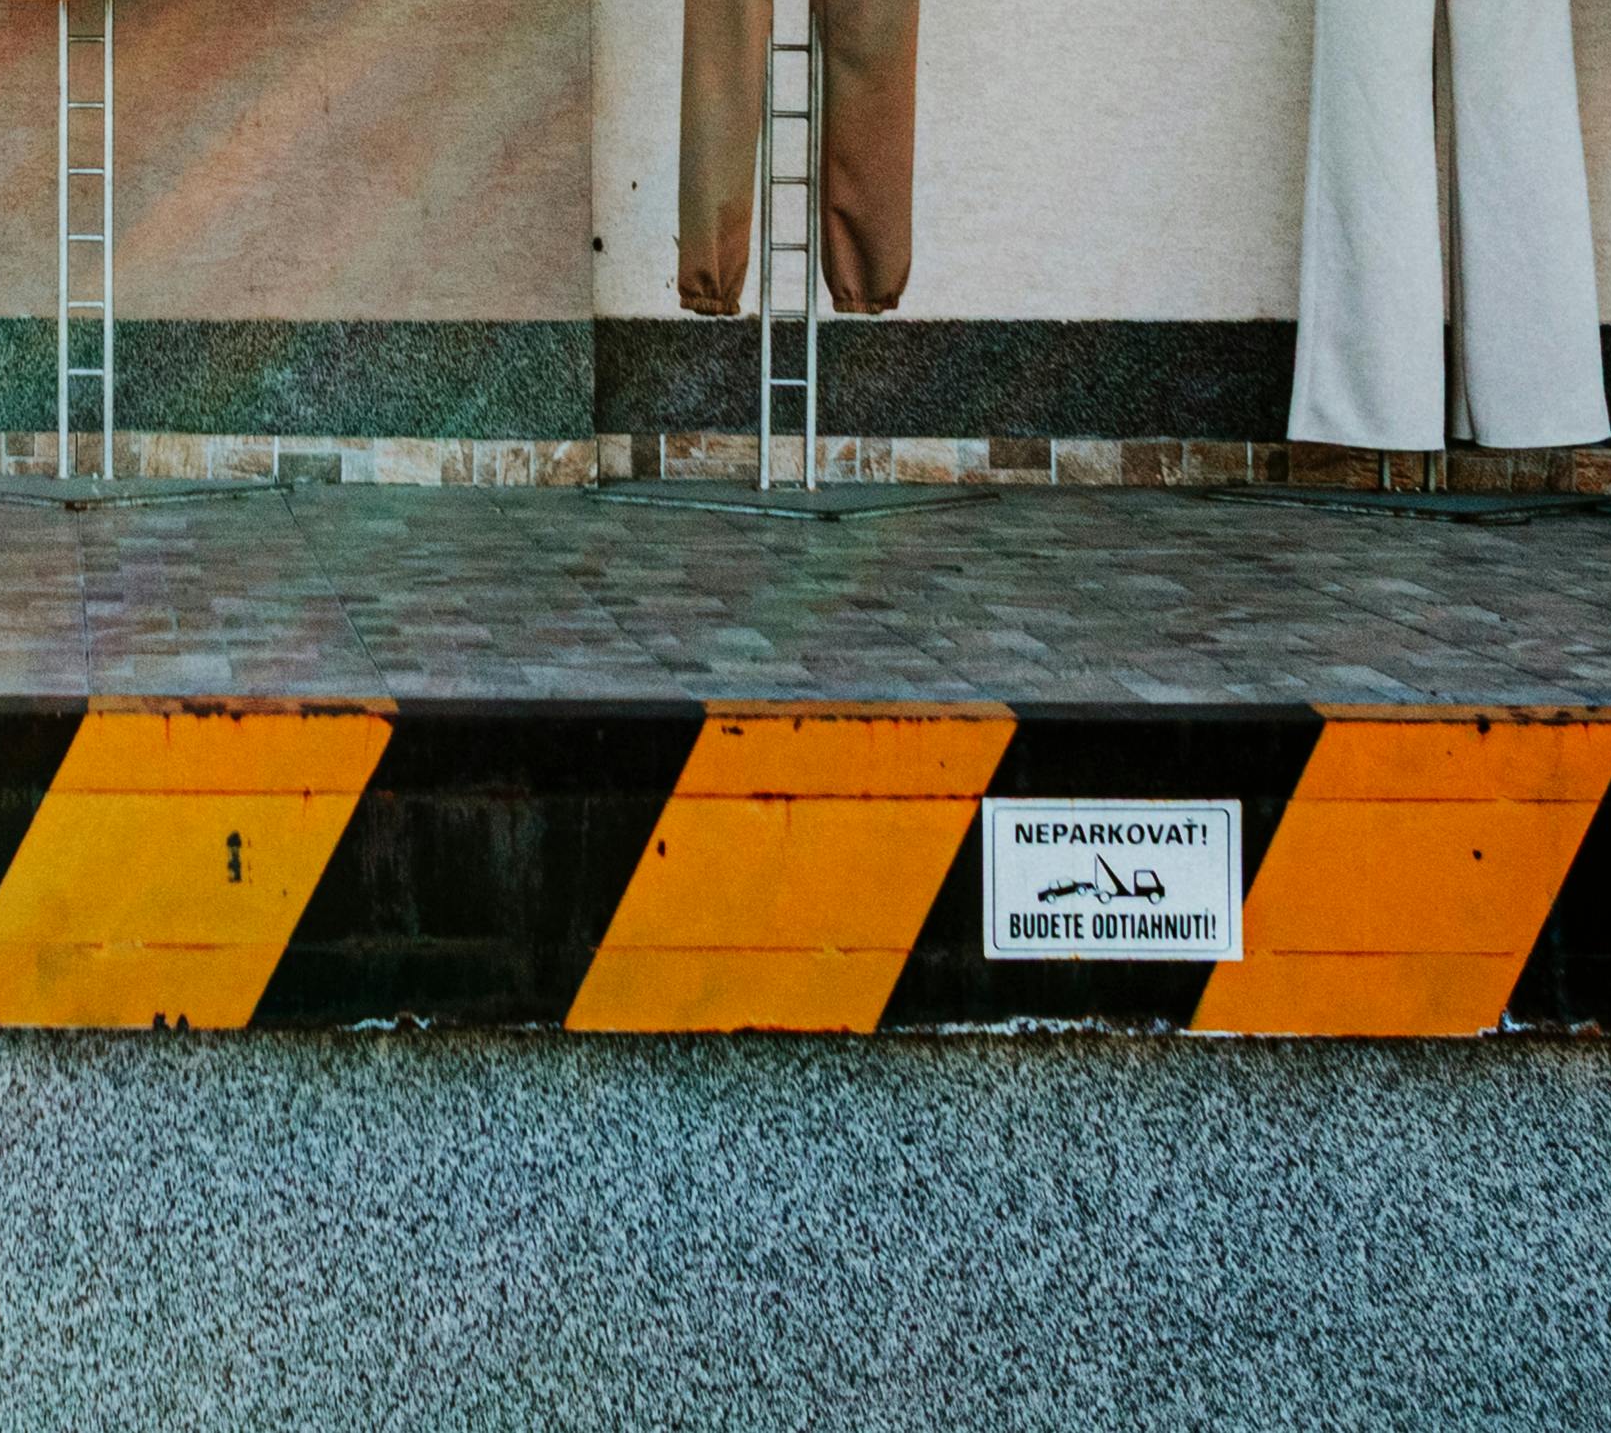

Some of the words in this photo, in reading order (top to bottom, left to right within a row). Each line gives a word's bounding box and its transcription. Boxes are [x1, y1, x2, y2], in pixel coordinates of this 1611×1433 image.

[1015, 816, 1207, 845] NEPARKOVAŤ!
[1010, 913, 1084, 939] BUDETE
[1093, 908, 1216, 940] ODTIAHNUTÍ!
